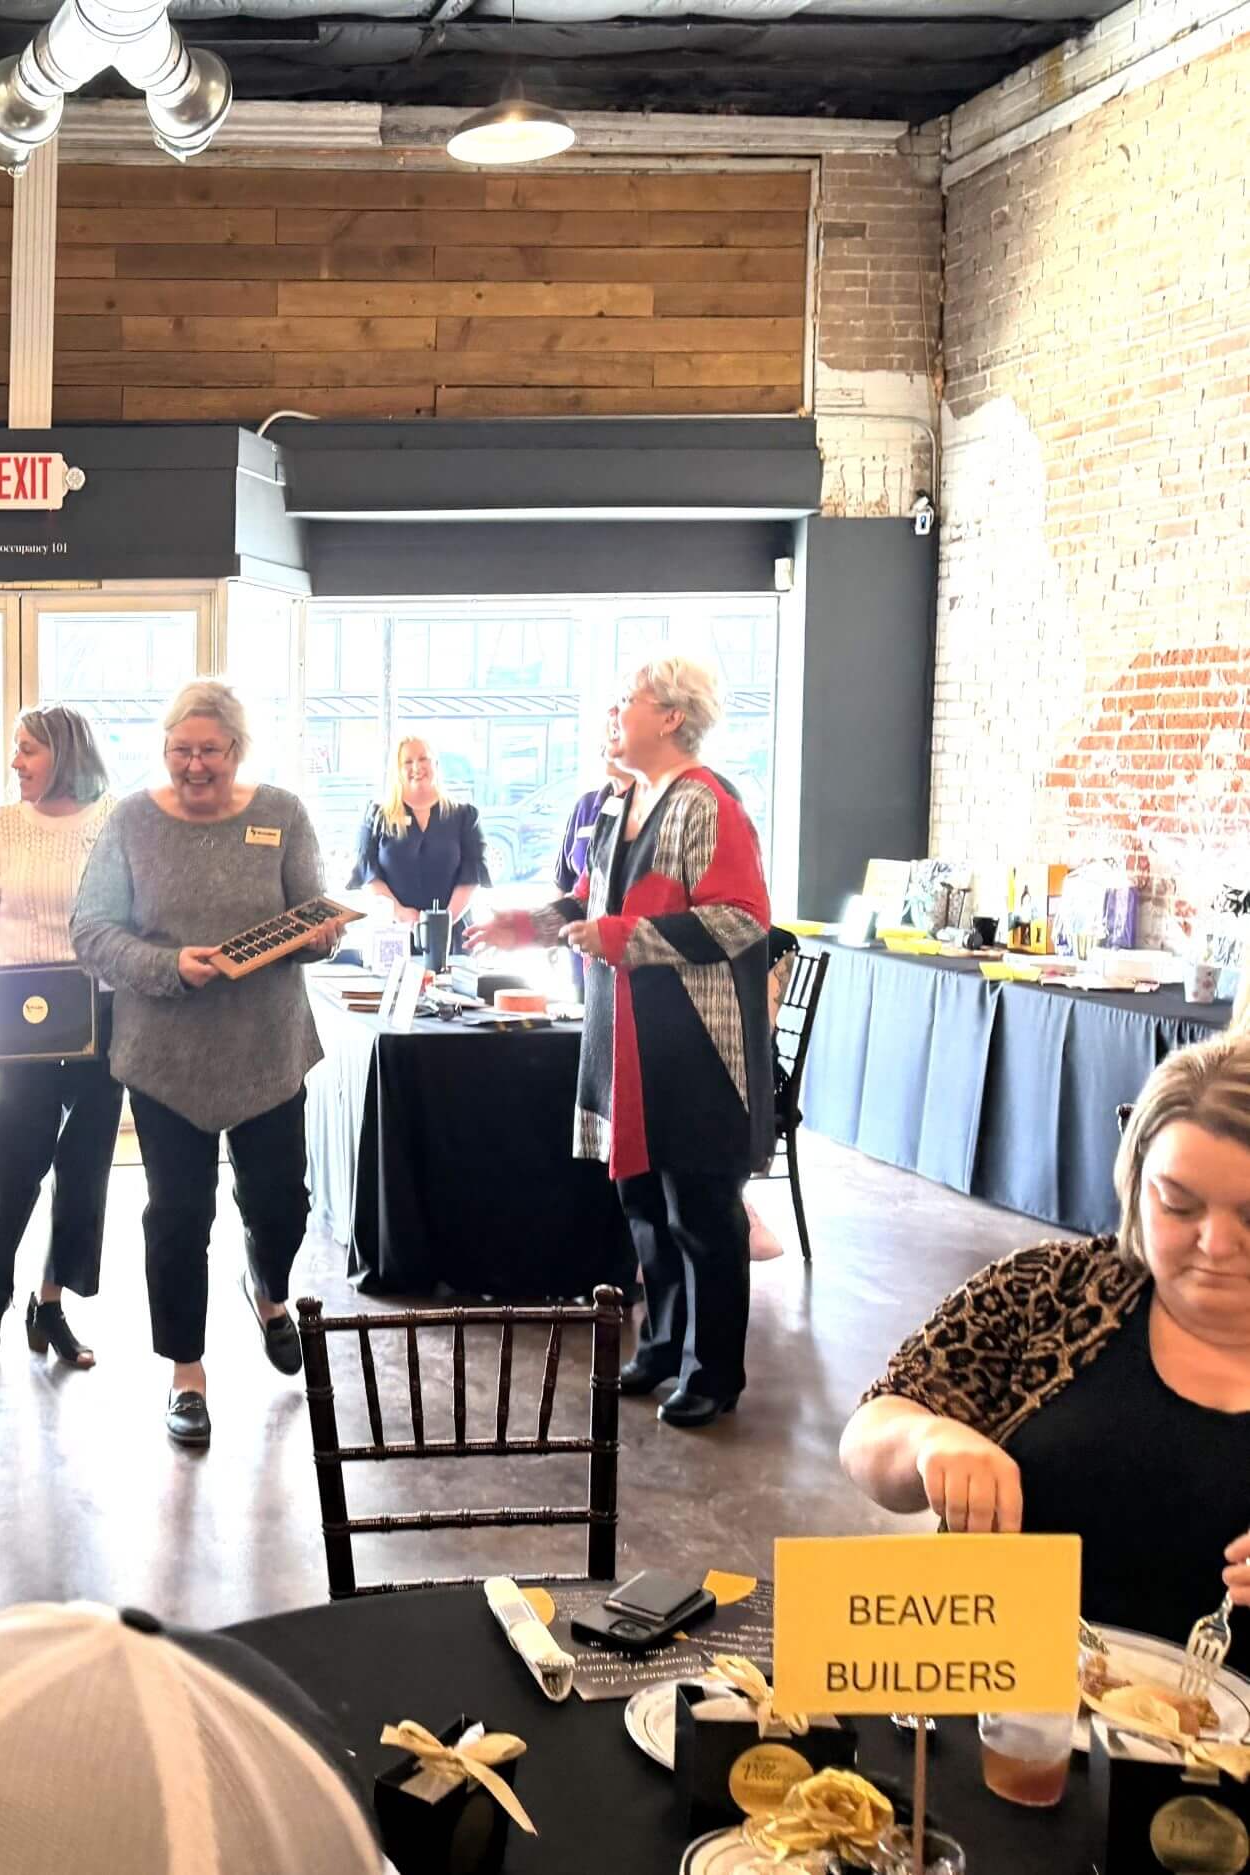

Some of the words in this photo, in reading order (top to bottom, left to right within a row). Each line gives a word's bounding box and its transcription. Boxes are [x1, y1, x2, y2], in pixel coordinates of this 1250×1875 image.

[0, 544, 48, 556] occupancy
[52, 542, 67, 553] 101
[849, 1594, 996, 1626] BEAVER
[826, 1660, 1016, 1693] BUILDERS
